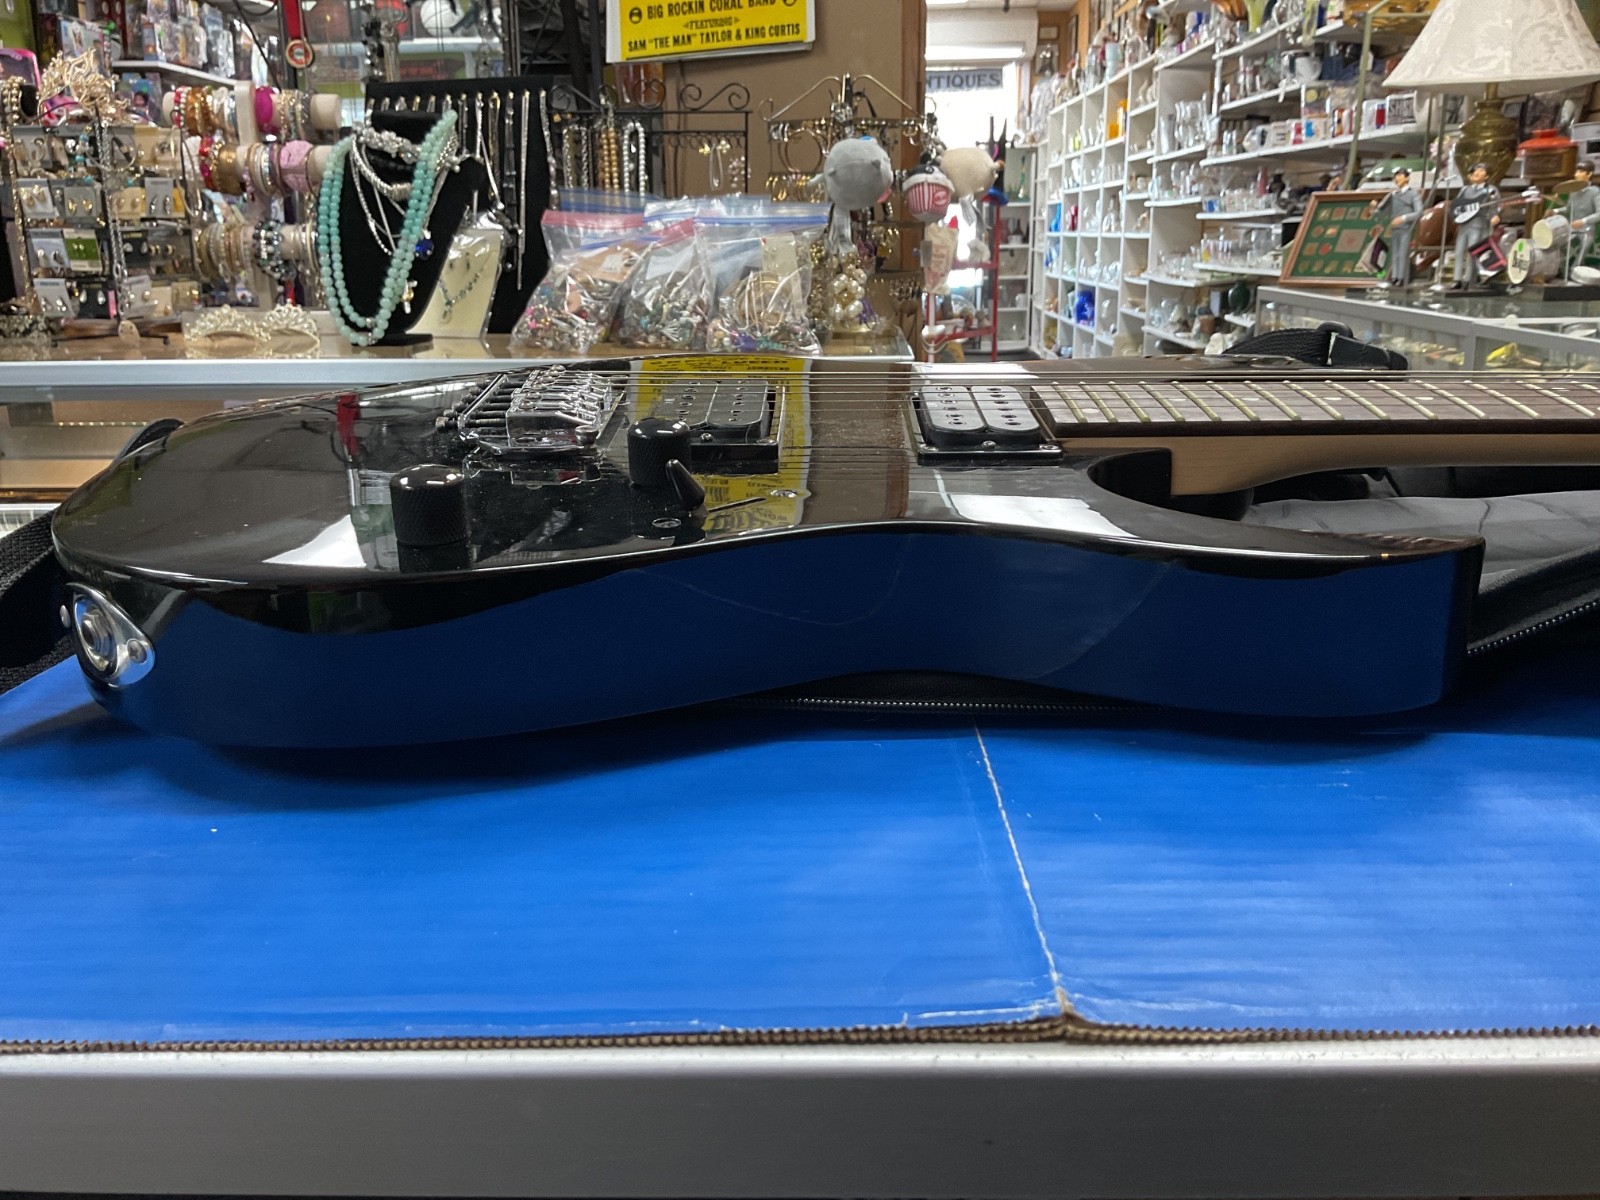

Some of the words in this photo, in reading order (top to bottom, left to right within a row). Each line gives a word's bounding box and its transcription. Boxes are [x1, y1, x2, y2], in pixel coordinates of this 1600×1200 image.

[647, 5, 664, 19] BIG
[668, 1, 704, 17] ROCKIN
[710, 0, 743, 12] CORAL
[690, 17, 732, 30] FEATURING
[628, 39, 646, 52] SAM
[700, 29, 732, 44] TAYLOR
[735, 28, 742, 41] &
[745, 26, 766, 40] KING
[768, 23, 800, 37] CURTIS
